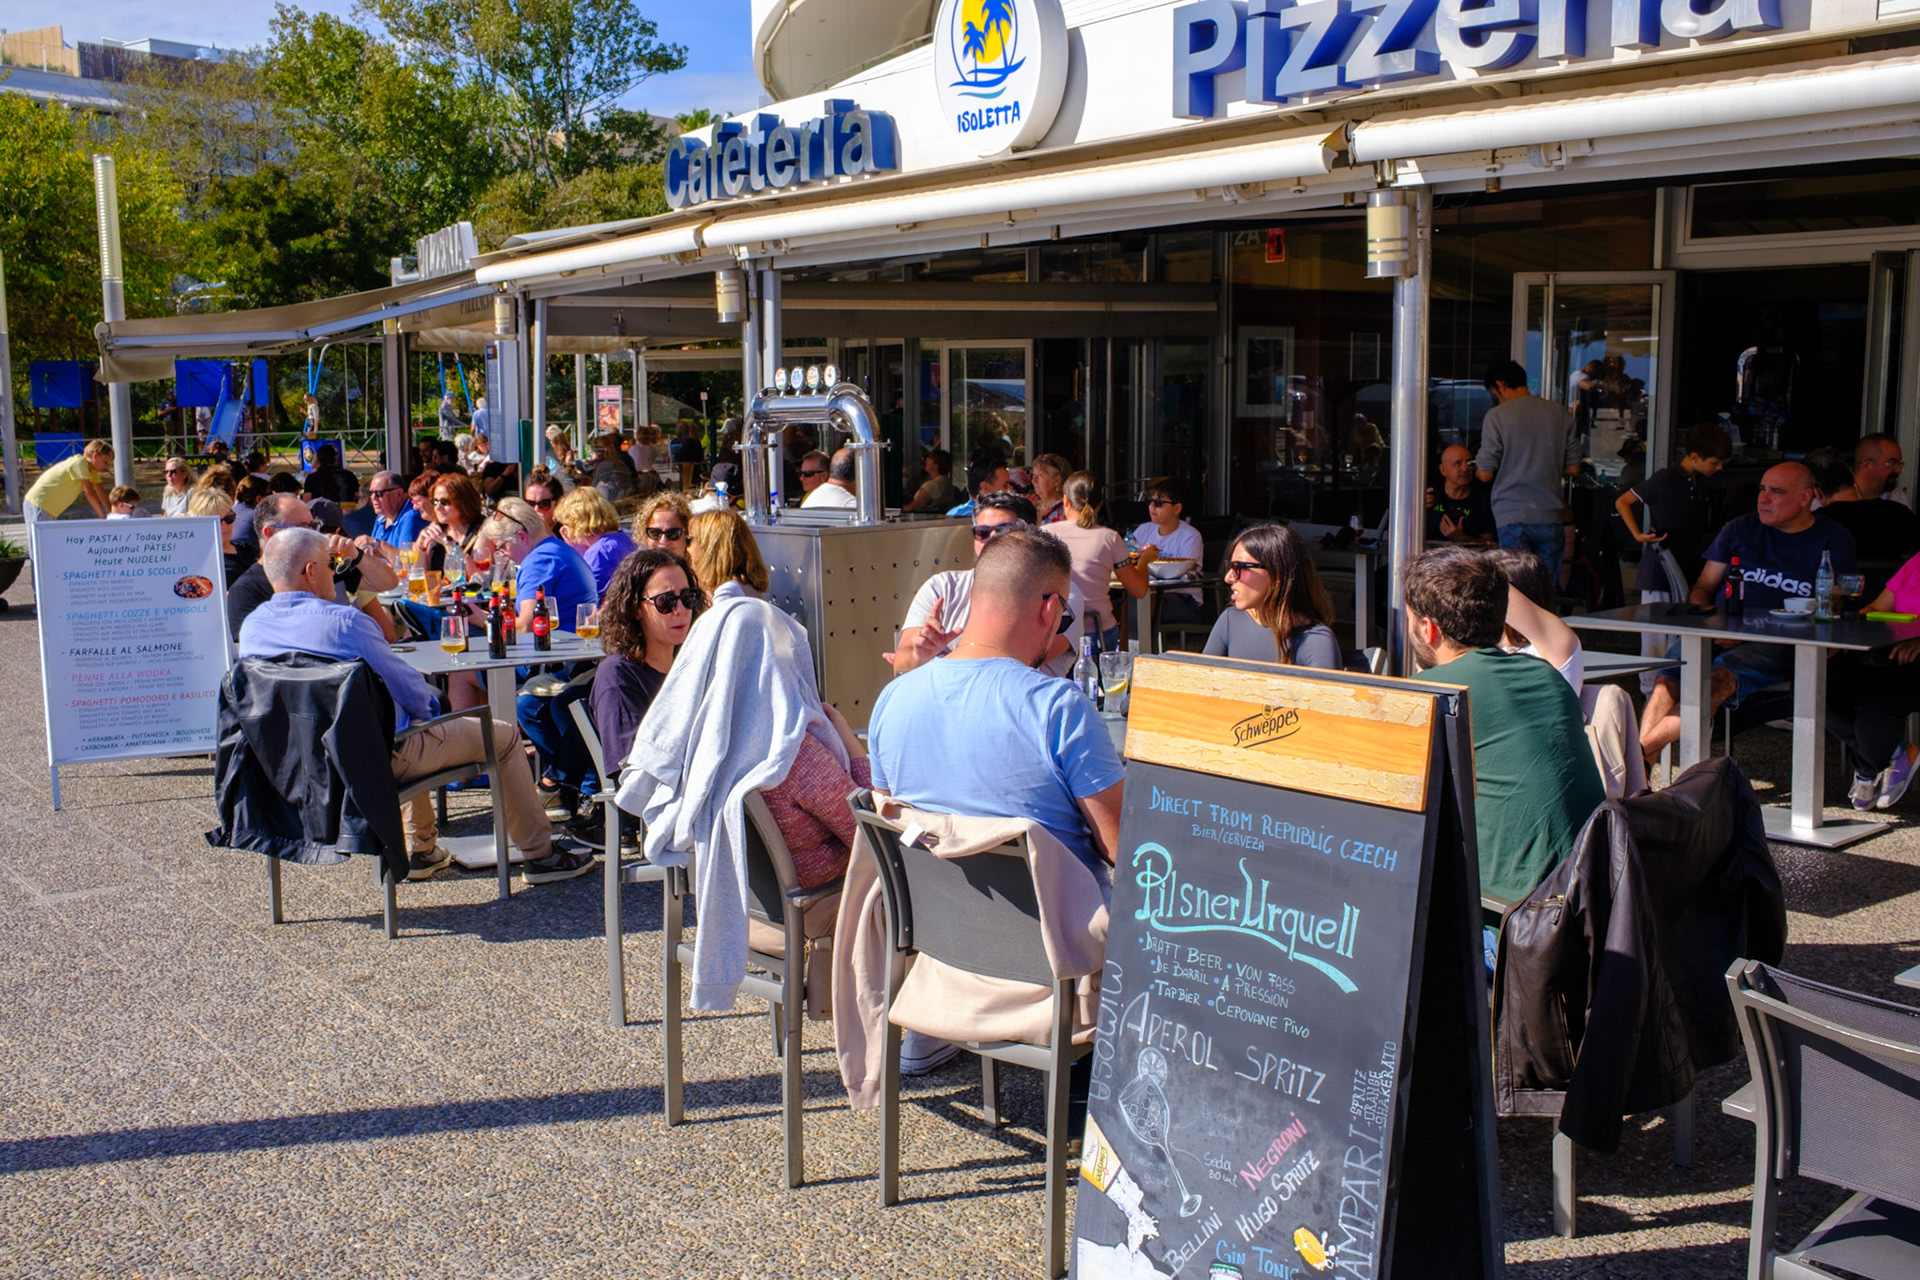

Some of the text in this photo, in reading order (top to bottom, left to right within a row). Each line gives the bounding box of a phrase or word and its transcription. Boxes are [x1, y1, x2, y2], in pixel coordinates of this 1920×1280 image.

[186, 457, 216, 466] APAS
[66, 536, 84, 544] Hoy
[88, 534, 122, 543] PASTA!
[136, 533, 162, 542] Today
[166, 531, 195, 540] PASTA
[94, 555, 171, 566] Heute NUDELN!
[63, 566, 188, 580] SPAGHETTI ALLO SCOGLIO
[1740, 568, 1812, 597] didas
[66, 612, 118, 621] SPAGHETTI
[122, 608, 150, 618] COZZE
[154, 608, 160, 616] E
[163, 605, 208, 615] VONGOLE
[70, 642, 183, 656] FARFALLE AL SALMONE
[71, 668, 172, 682] PENNE ALLA WODKA
[71, 698, 117, 708] SPAGHETTI
[120, 694, 169, 704] POMODORO
[180, 690, 216, 699] BASILICO
[88, 728, 211, 743] ARRABBIATA PUTTANESCA BOLOGNESE
[1233, 708, 1299, 746] Schweppes
[81, 743, 119, 751] CARBONARA
[124, 739, 166, 747] AMATRICIANA
[1209, 803, 1252, 831] FROM
[1340, 839, 1398, 872] CZECH
[1132, 842, 1360, 961] Pilsner Urquell
[1142, 931, 1296, 994] DRAFT BEER VON FASS
[1221, 974, 1230, 991] A
[1119, 991, 1218, 1071] APEROL
[1350, 1068, 1367, 1116] SPRITZ
[1363, 1070, 1381, 1121] ORANGE
[1375, 1041, 1397, 1128] SHAKERATO
[1335, 1124, 1384, 1280] AMPARI
[1235, 1196, 1278, 1242] HUGO
